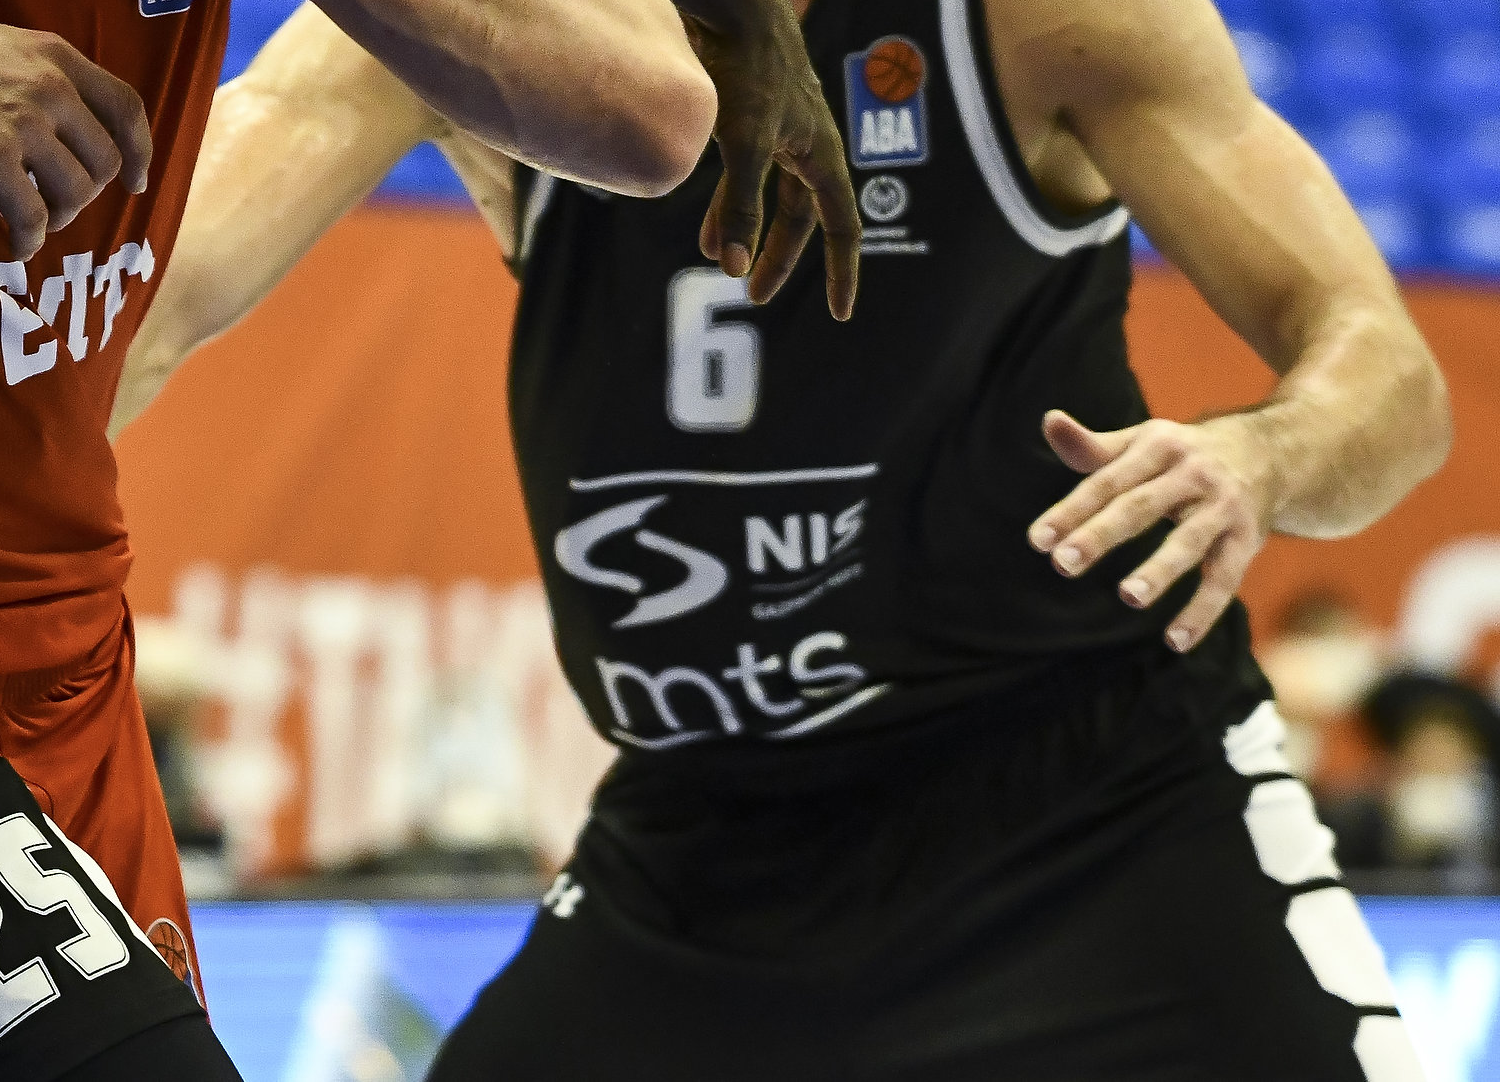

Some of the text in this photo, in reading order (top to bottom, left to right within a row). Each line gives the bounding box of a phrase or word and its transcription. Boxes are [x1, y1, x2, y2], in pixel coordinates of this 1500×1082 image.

[859, 107, 918, 155] ABA
[665, 266, 763, 433] 6
[744, 497, 868, 575] NIS
[596, 630, 869, 735] mts
